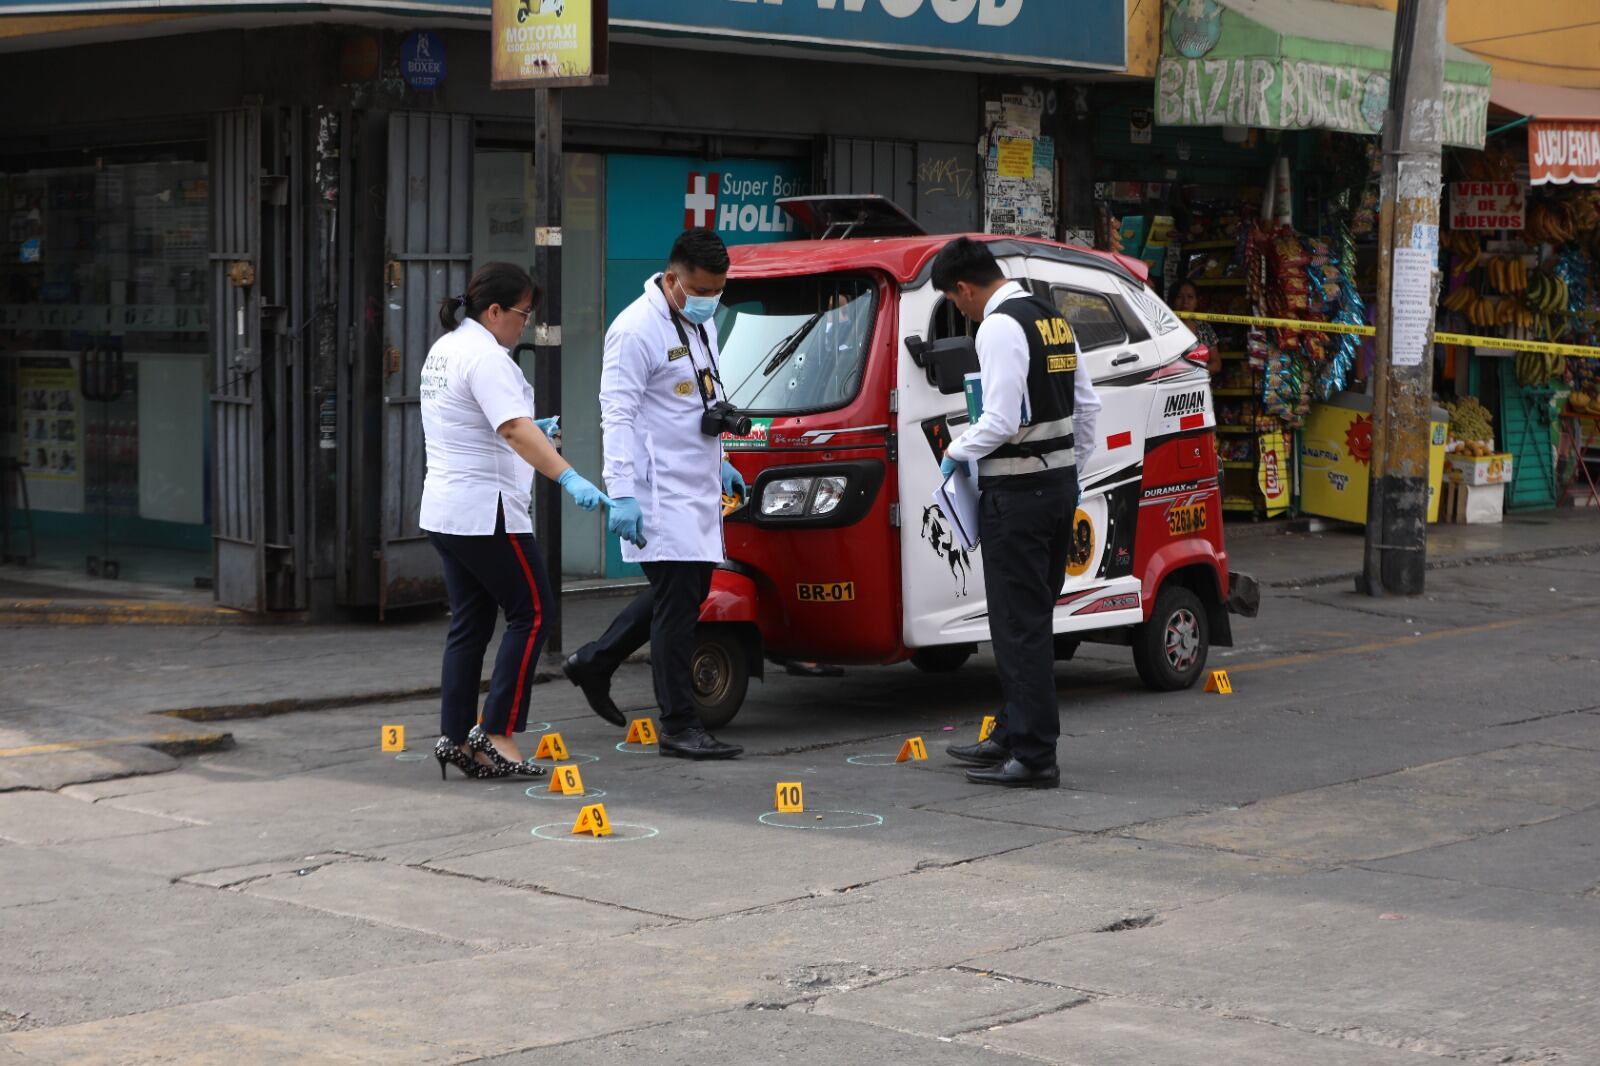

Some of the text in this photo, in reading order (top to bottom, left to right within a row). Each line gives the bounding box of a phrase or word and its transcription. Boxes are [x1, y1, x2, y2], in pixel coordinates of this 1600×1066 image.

[506, 24, 577, 43] MOTOTAXI
[408, 60, 441, 73] BOXER
[1159, 59, 1275, 126] BAZAR
[1279, 62, 1364, 132] BODEGA
[722, 172, 768, 201] Super
[1456, 183, 1519, 196] VENTA
[1477, 200, 1497, 211] DE
[1454, 215, 1522, 228] HUEVOS
[1163, 390, 1205, 413] INDIAN
[1164, 408, 1206, 418] MOTOS
[1144, 484, 1186, 497] DURAMAX
[799, 583, 853, 600] BR-01
[388, 728, 397, 745] 3
[641, 721, 651, 738] 5
[553, 737, 562, 754] 4
[914, 741, 922, 758] 7
[565, 769, 575, 787] 6
[779, 786, 800, 805] 10
[592, 808, 603, 827] 9
